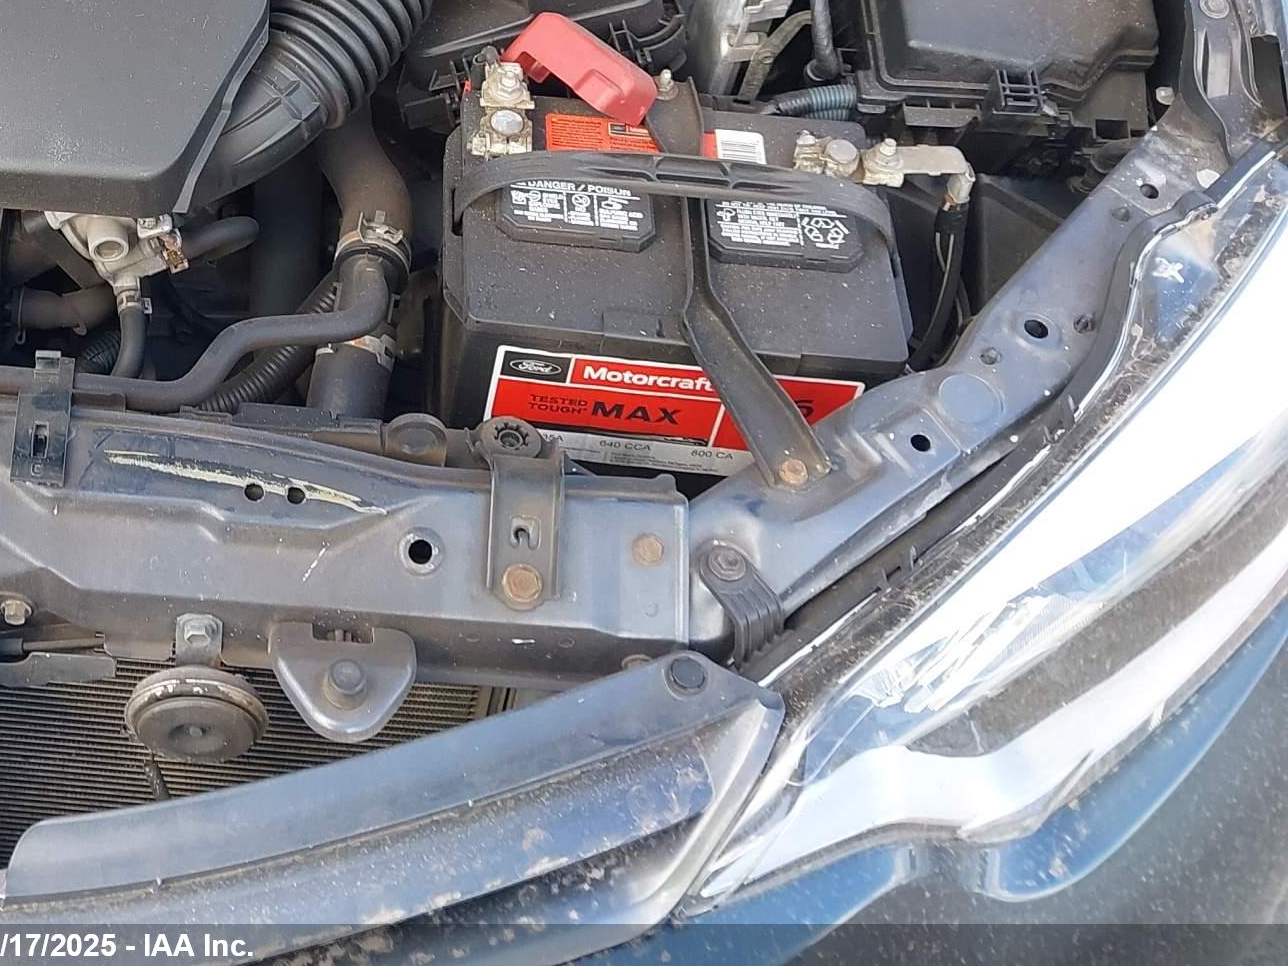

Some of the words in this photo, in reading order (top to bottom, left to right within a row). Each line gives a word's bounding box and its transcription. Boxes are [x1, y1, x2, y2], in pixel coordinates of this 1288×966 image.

[517, 359, 553, 374] Ford
[582, 365, 715, 392] Motorcraft
[529, 393, 588, 407] TESTED
[591, 400, 682, 426] MAX
[599, 439, 621, 449] 640
[624, 442, 652, 452] CCA
[715, 451, 734, 460] CA
